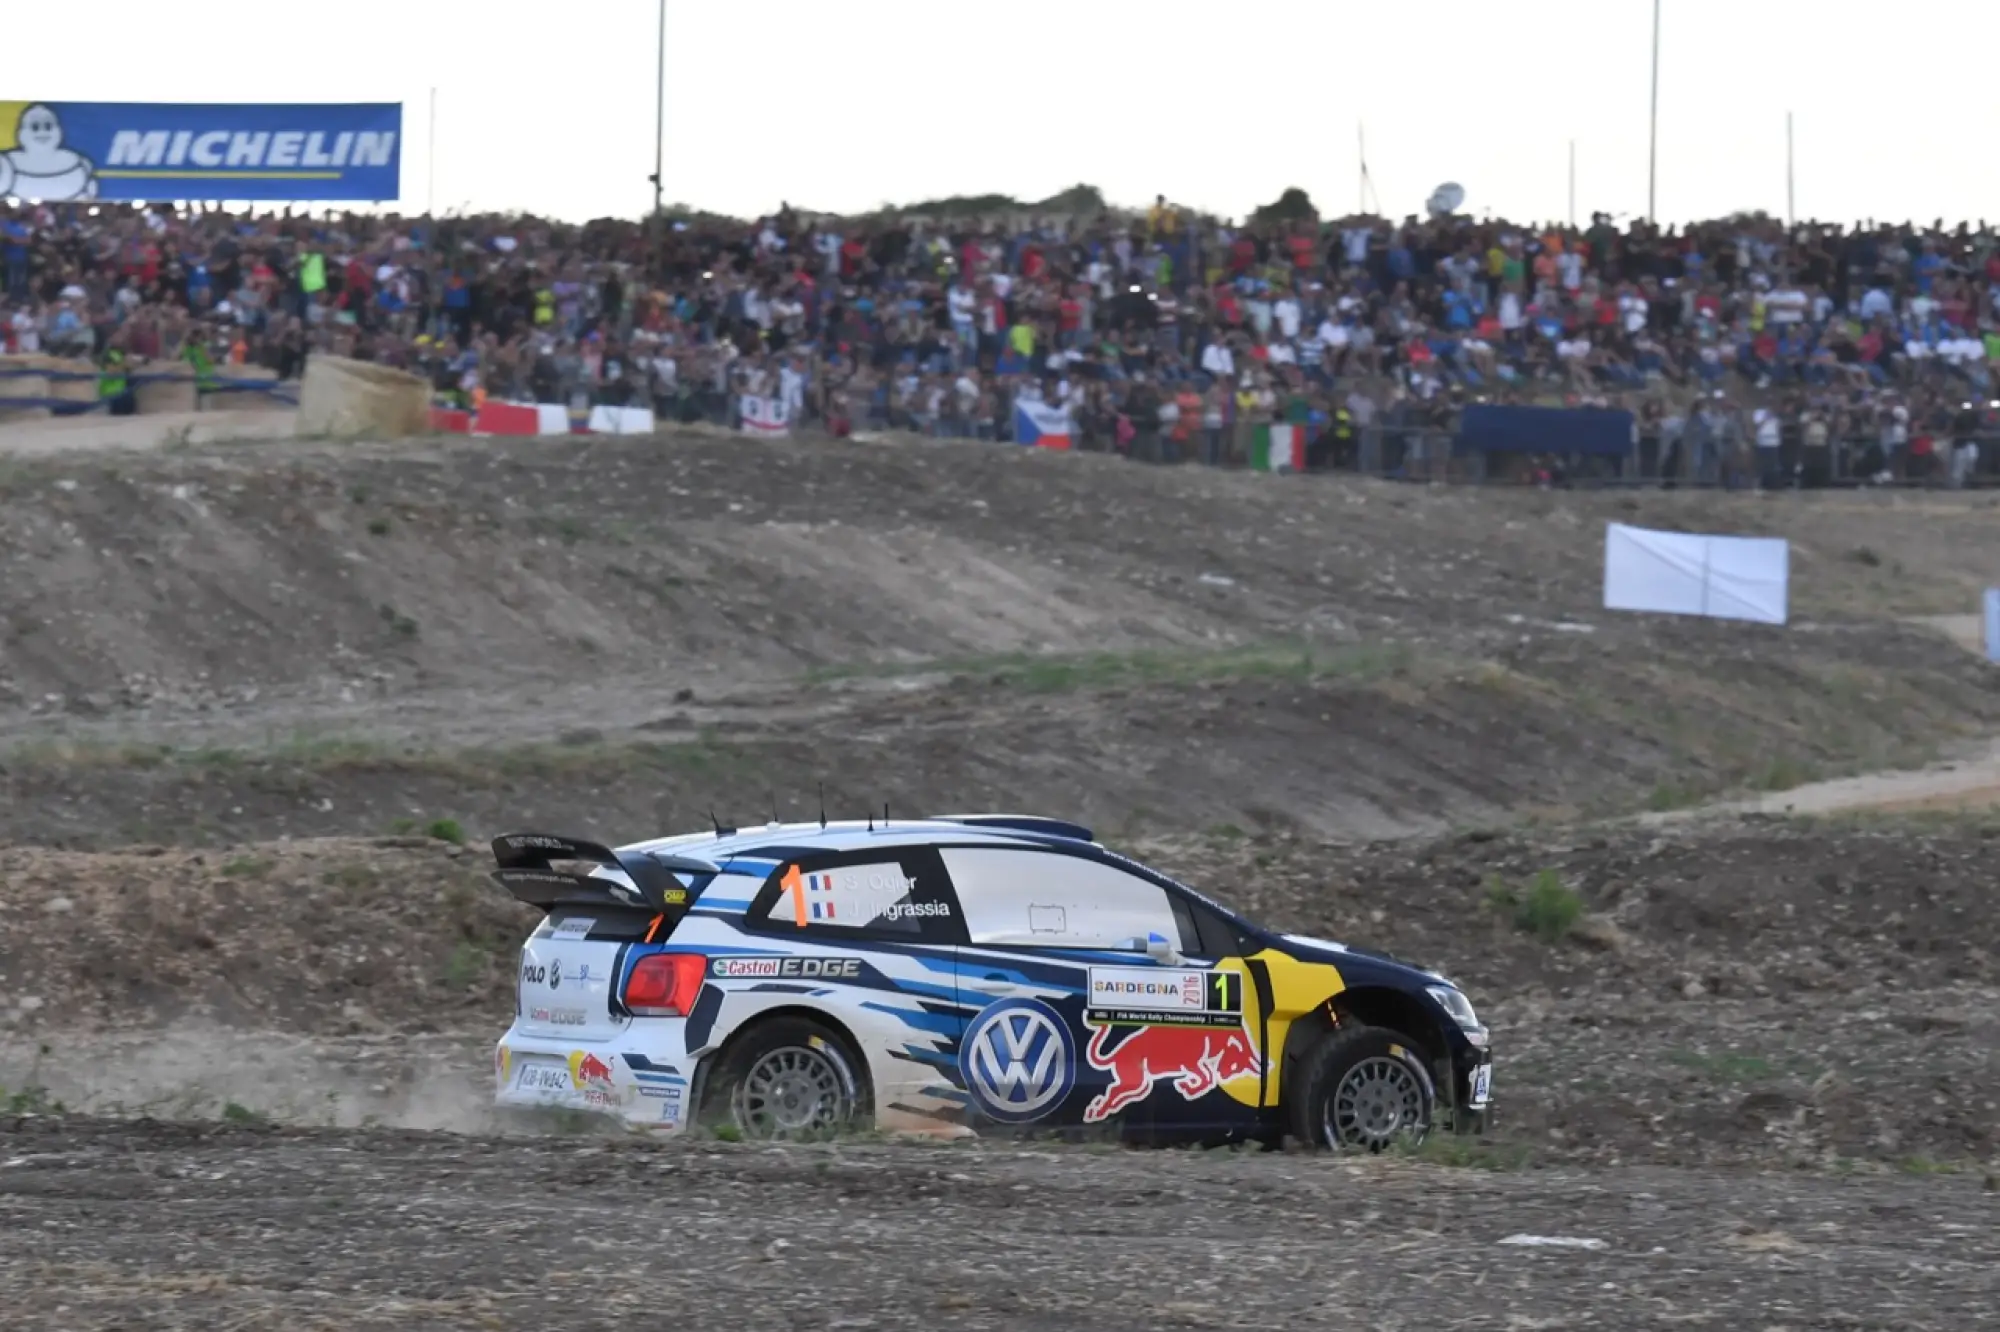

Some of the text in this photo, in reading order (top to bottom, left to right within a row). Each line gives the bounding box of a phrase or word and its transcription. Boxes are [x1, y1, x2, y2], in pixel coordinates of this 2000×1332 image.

[106, 130, 396, 167] MICHELIN
[780, 864, 807, 927] 1
[870, 899, 951, 921] Ingrassia
[644, 911, 664, 944] 1
[522, 964, 545, 985] POLO
[729, 959, 862, 977] Castrol EDGE
[1094, 980, 1178, 996] SARDEGNA
[1183, 975, 1200, 1005] 2016
[1215, 973, 1228, 1012] 1
[1129, 1011, 1146, 1019] World
